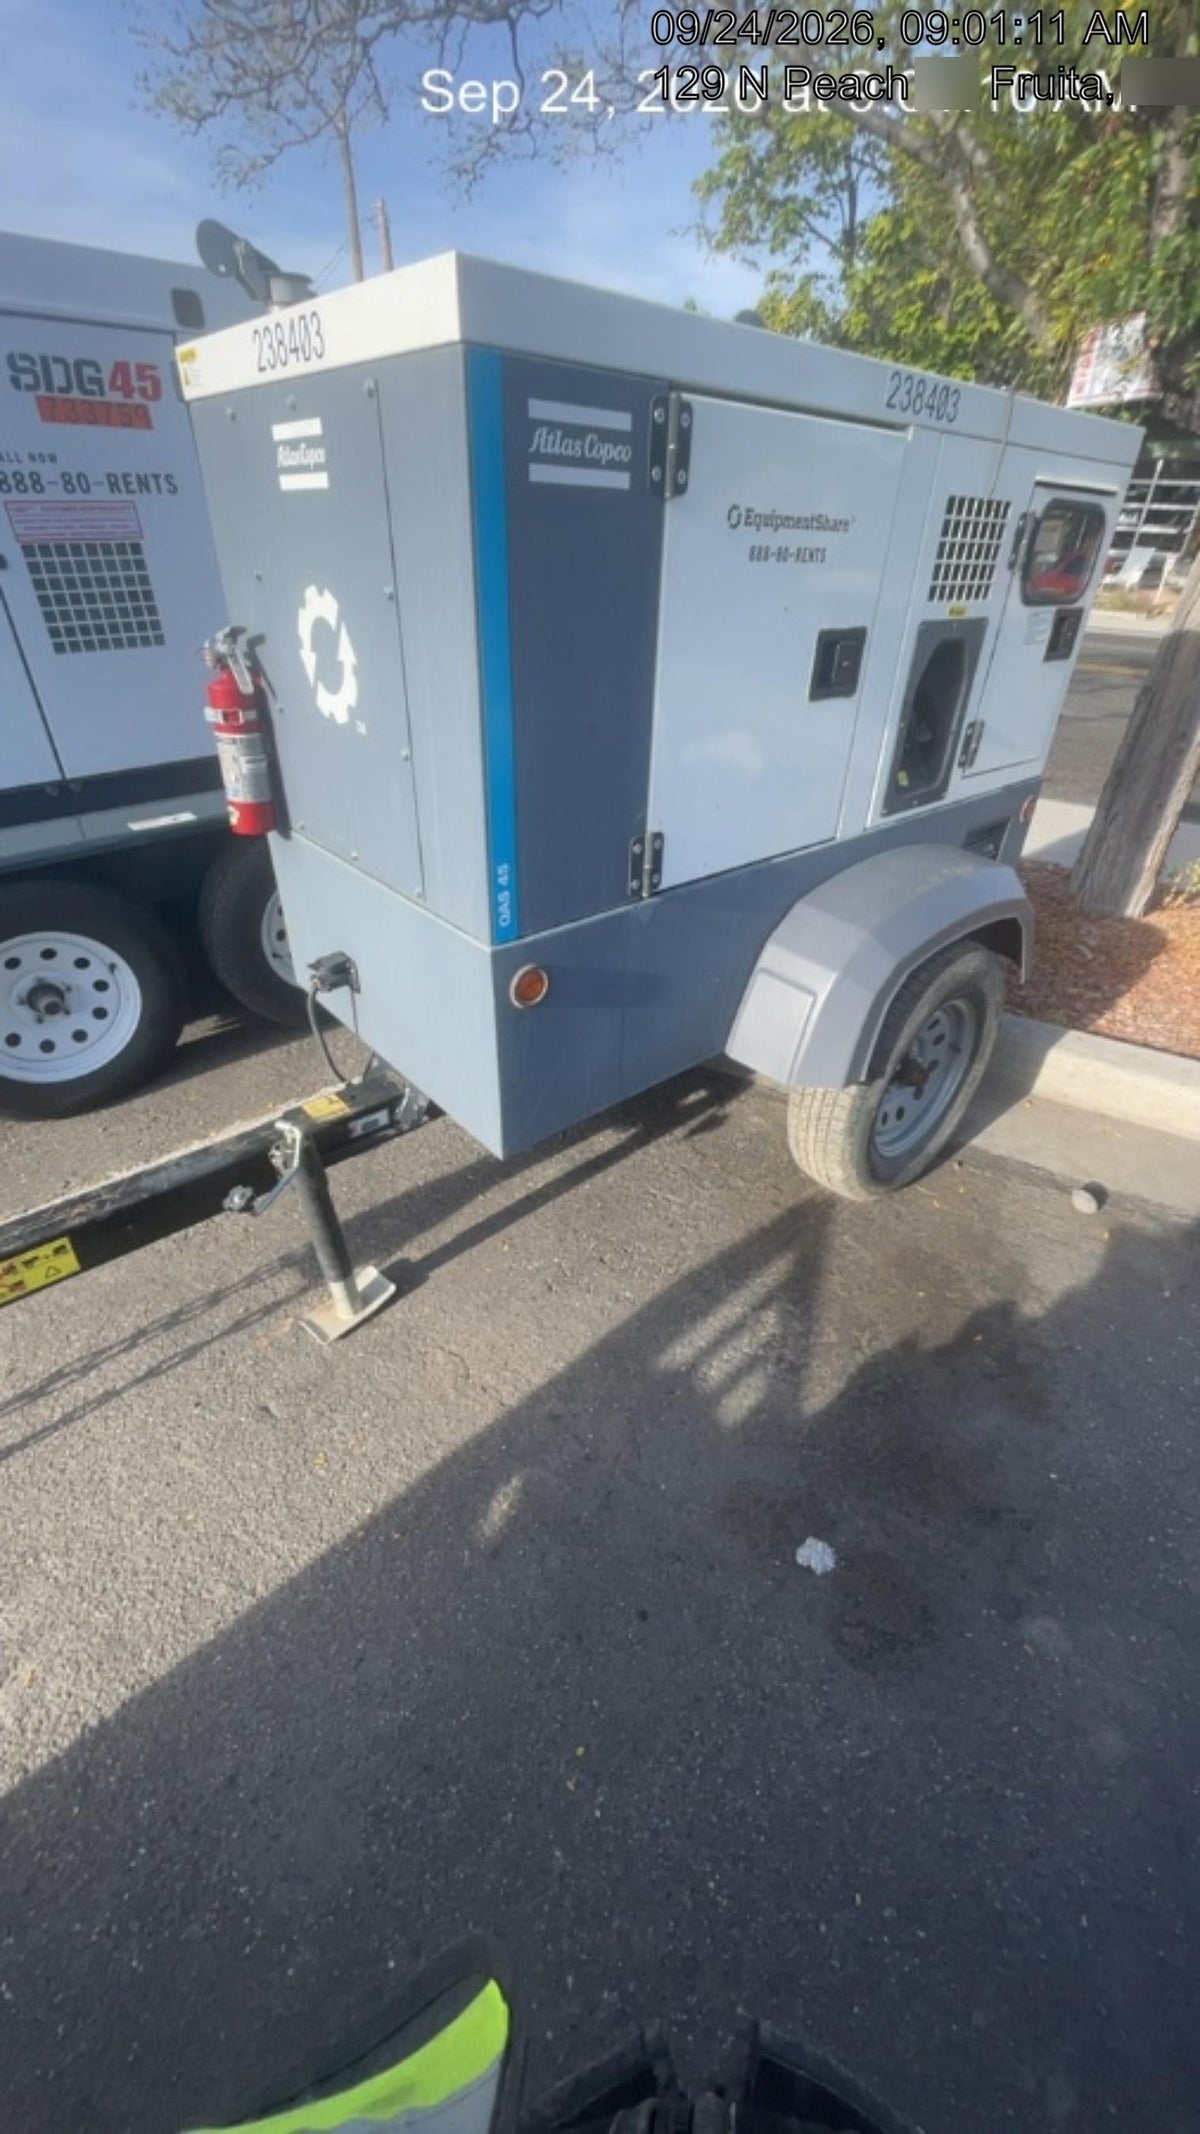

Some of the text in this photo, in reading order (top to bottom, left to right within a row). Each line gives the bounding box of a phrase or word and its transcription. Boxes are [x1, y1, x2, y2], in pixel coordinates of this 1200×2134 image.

[252, 310, 326, 374] 238403
[886, 370, 961, 423] 238403
[0, 470, 179, 495] 888-80-RENTS
